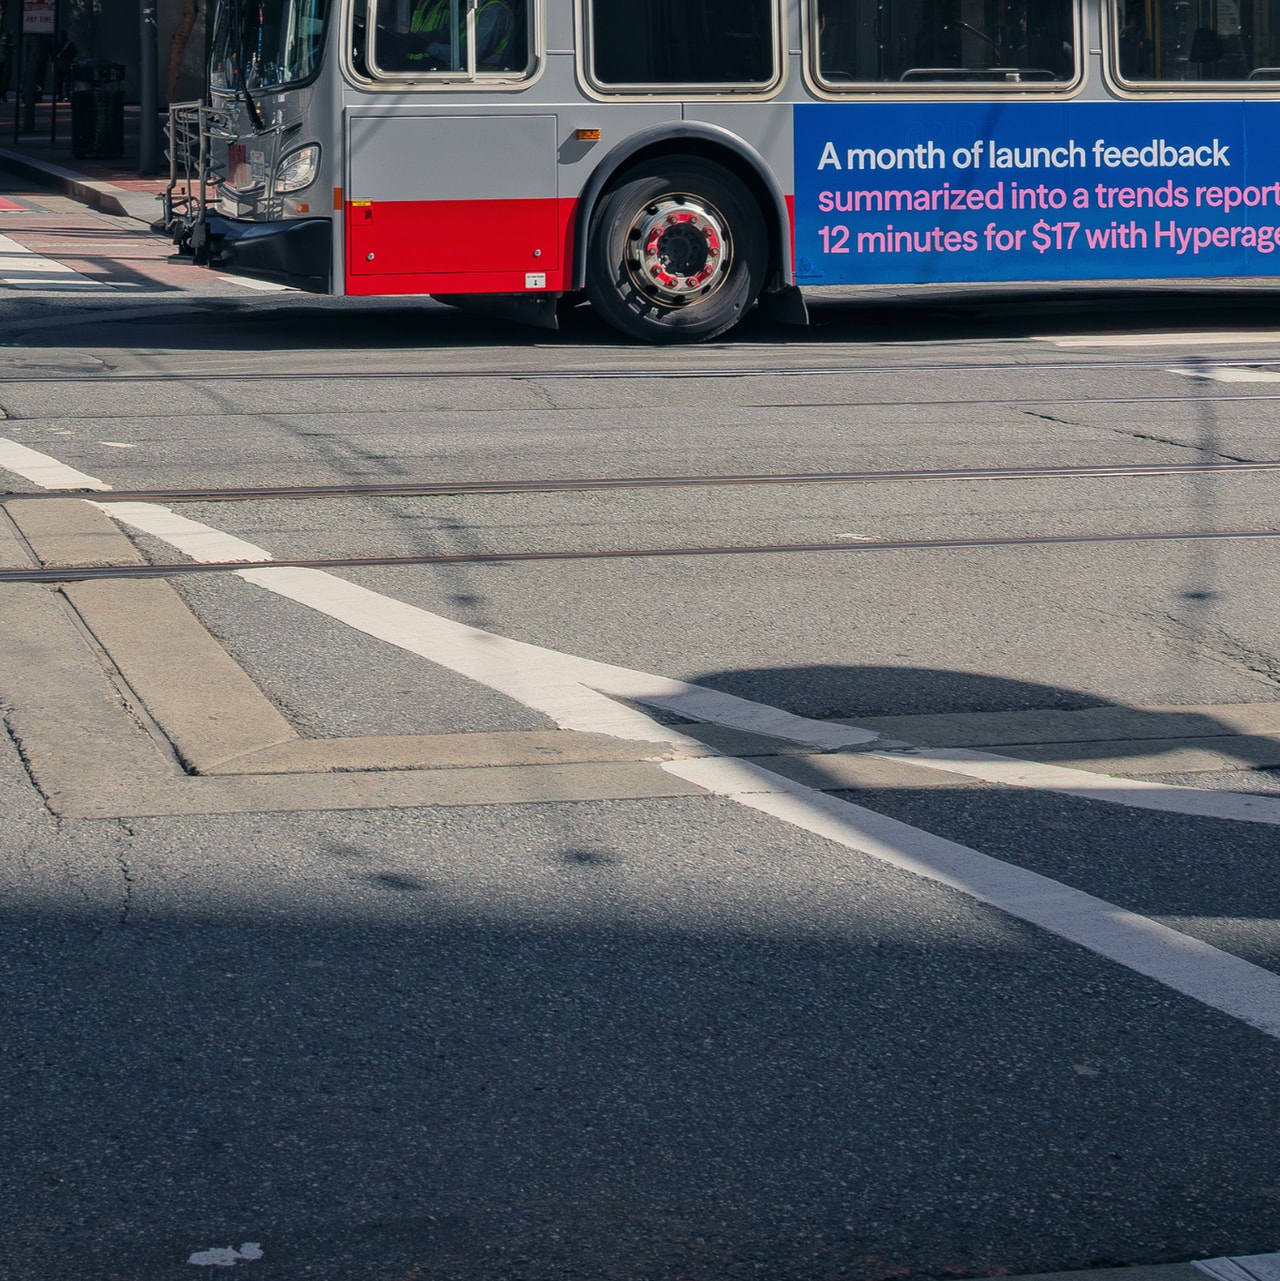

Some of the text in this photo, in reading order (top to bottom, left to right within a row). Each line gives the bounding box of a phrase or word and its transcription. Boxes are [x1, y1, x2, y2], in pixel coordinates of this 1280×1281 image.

[817, 138, 1231, 170] A month of launch feedback
[818, 181, 1004, 212] summarized
[1011, 181, 1067, 210] into
[1072, 187, 1089, 208] a
[1095, 179, 1189, 208] trends
[818, 225, 850, 254] 12
[857, 224, 978, 253] minutes
[984, 222, 1026, 251] for
[1032, 218, 1081, 254] $17
[1085, 220, 1147, 249] with
